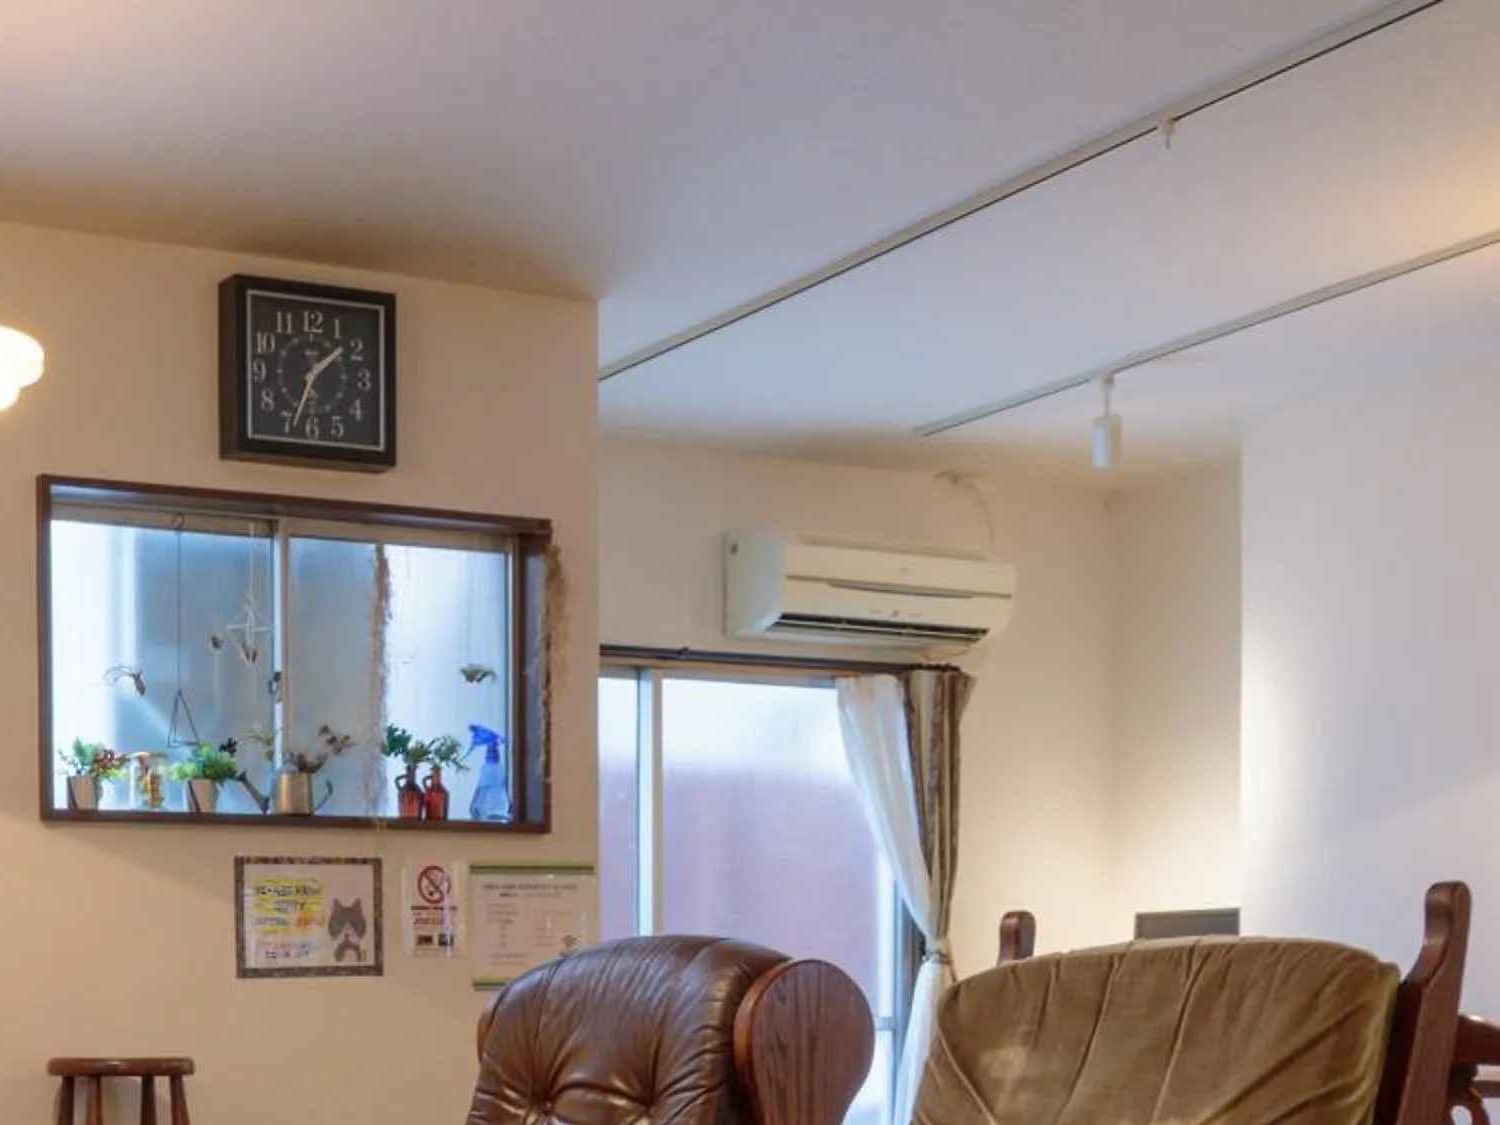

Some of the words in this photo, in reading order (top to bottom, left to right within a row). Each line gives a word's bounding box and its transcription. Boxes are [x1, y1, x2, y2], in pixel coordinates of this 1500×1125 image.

[276, 310, 293, 334] 11
[303, 310, 324, 333] 12
[333, 317, 342, 339] 1
[256, 332, 275, 354] 10
[350, 338, 364, 361] 2
[253, 360, 266, 381] 9
[357, 369, 372, 391] 3
[261, 388, 274, 411] 8
[350, 399, 363, 421] 4
[280, 412, 292, 433] 7
[305, 417, 319, 439] 6
[331, 416, 344, 438] 5
